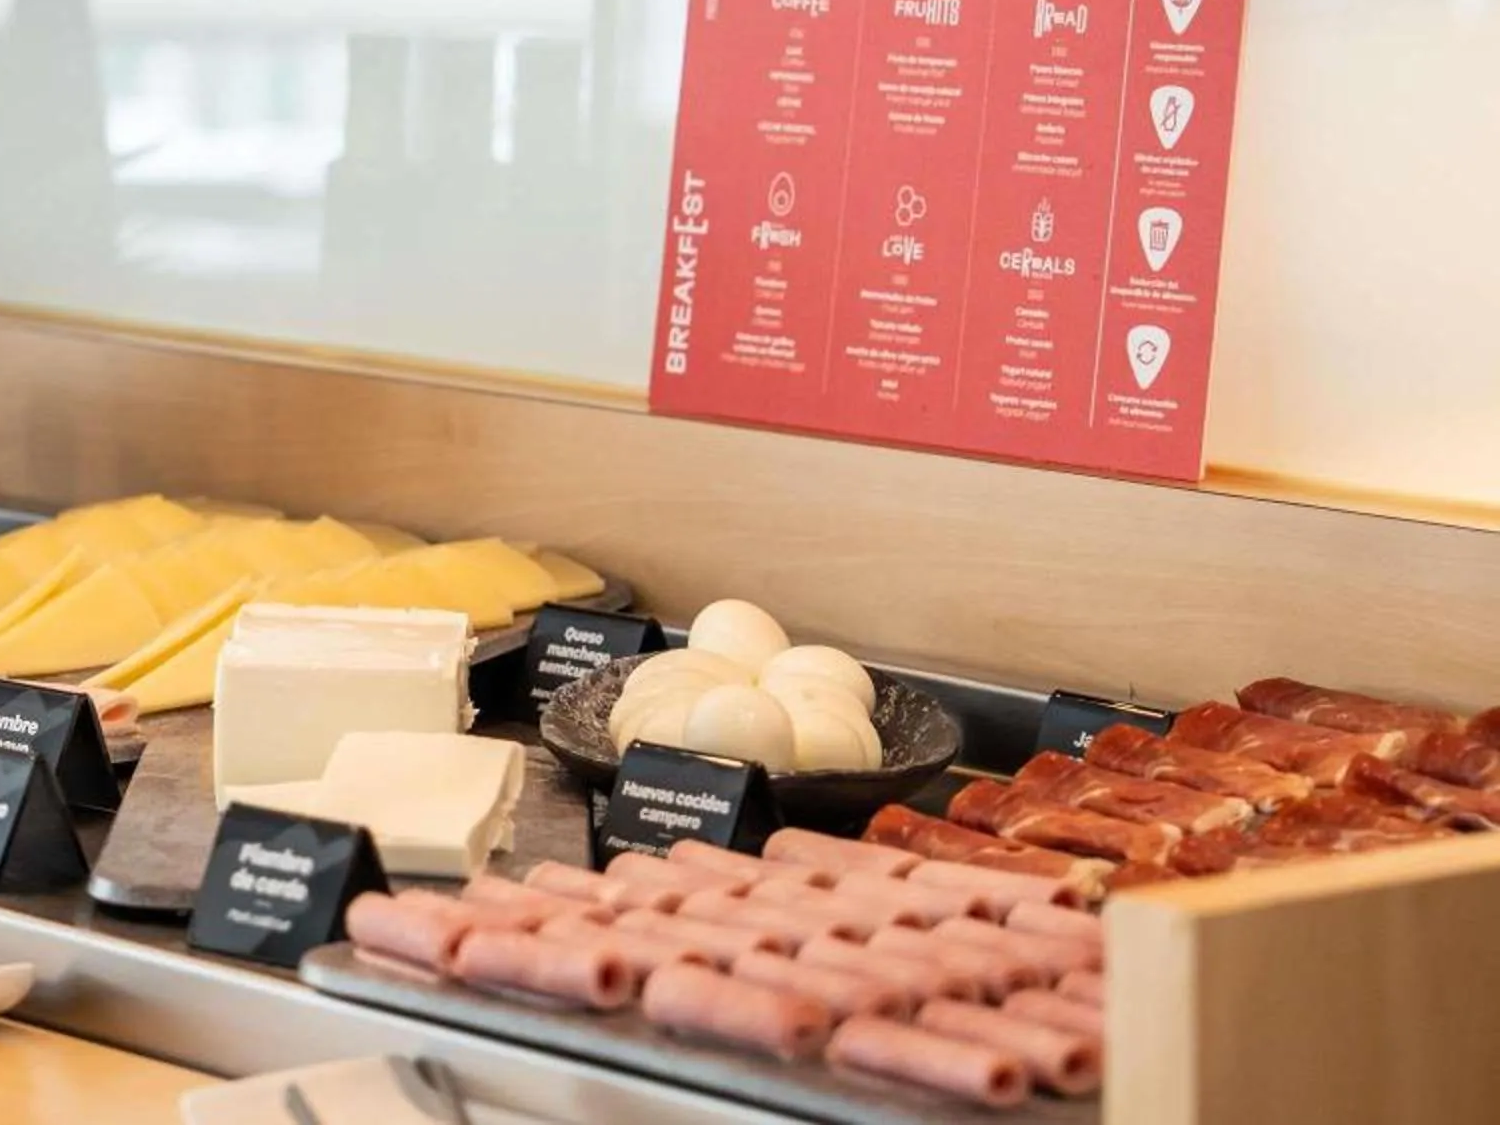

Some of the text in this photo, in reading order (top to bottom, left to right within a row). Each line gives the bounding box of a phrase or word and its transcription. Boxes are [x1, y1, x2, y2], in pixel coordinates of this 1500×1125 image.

[883, 235, 924, 265] LOVE
[666, 170, 708, 374] BREAKFEST
[564, 626, 605, 645] Queso
[546, 643, 611, 667] manchego
[621, 780, 731, 814] Huevos cocidos
[639, 807, 702, 830] campero
